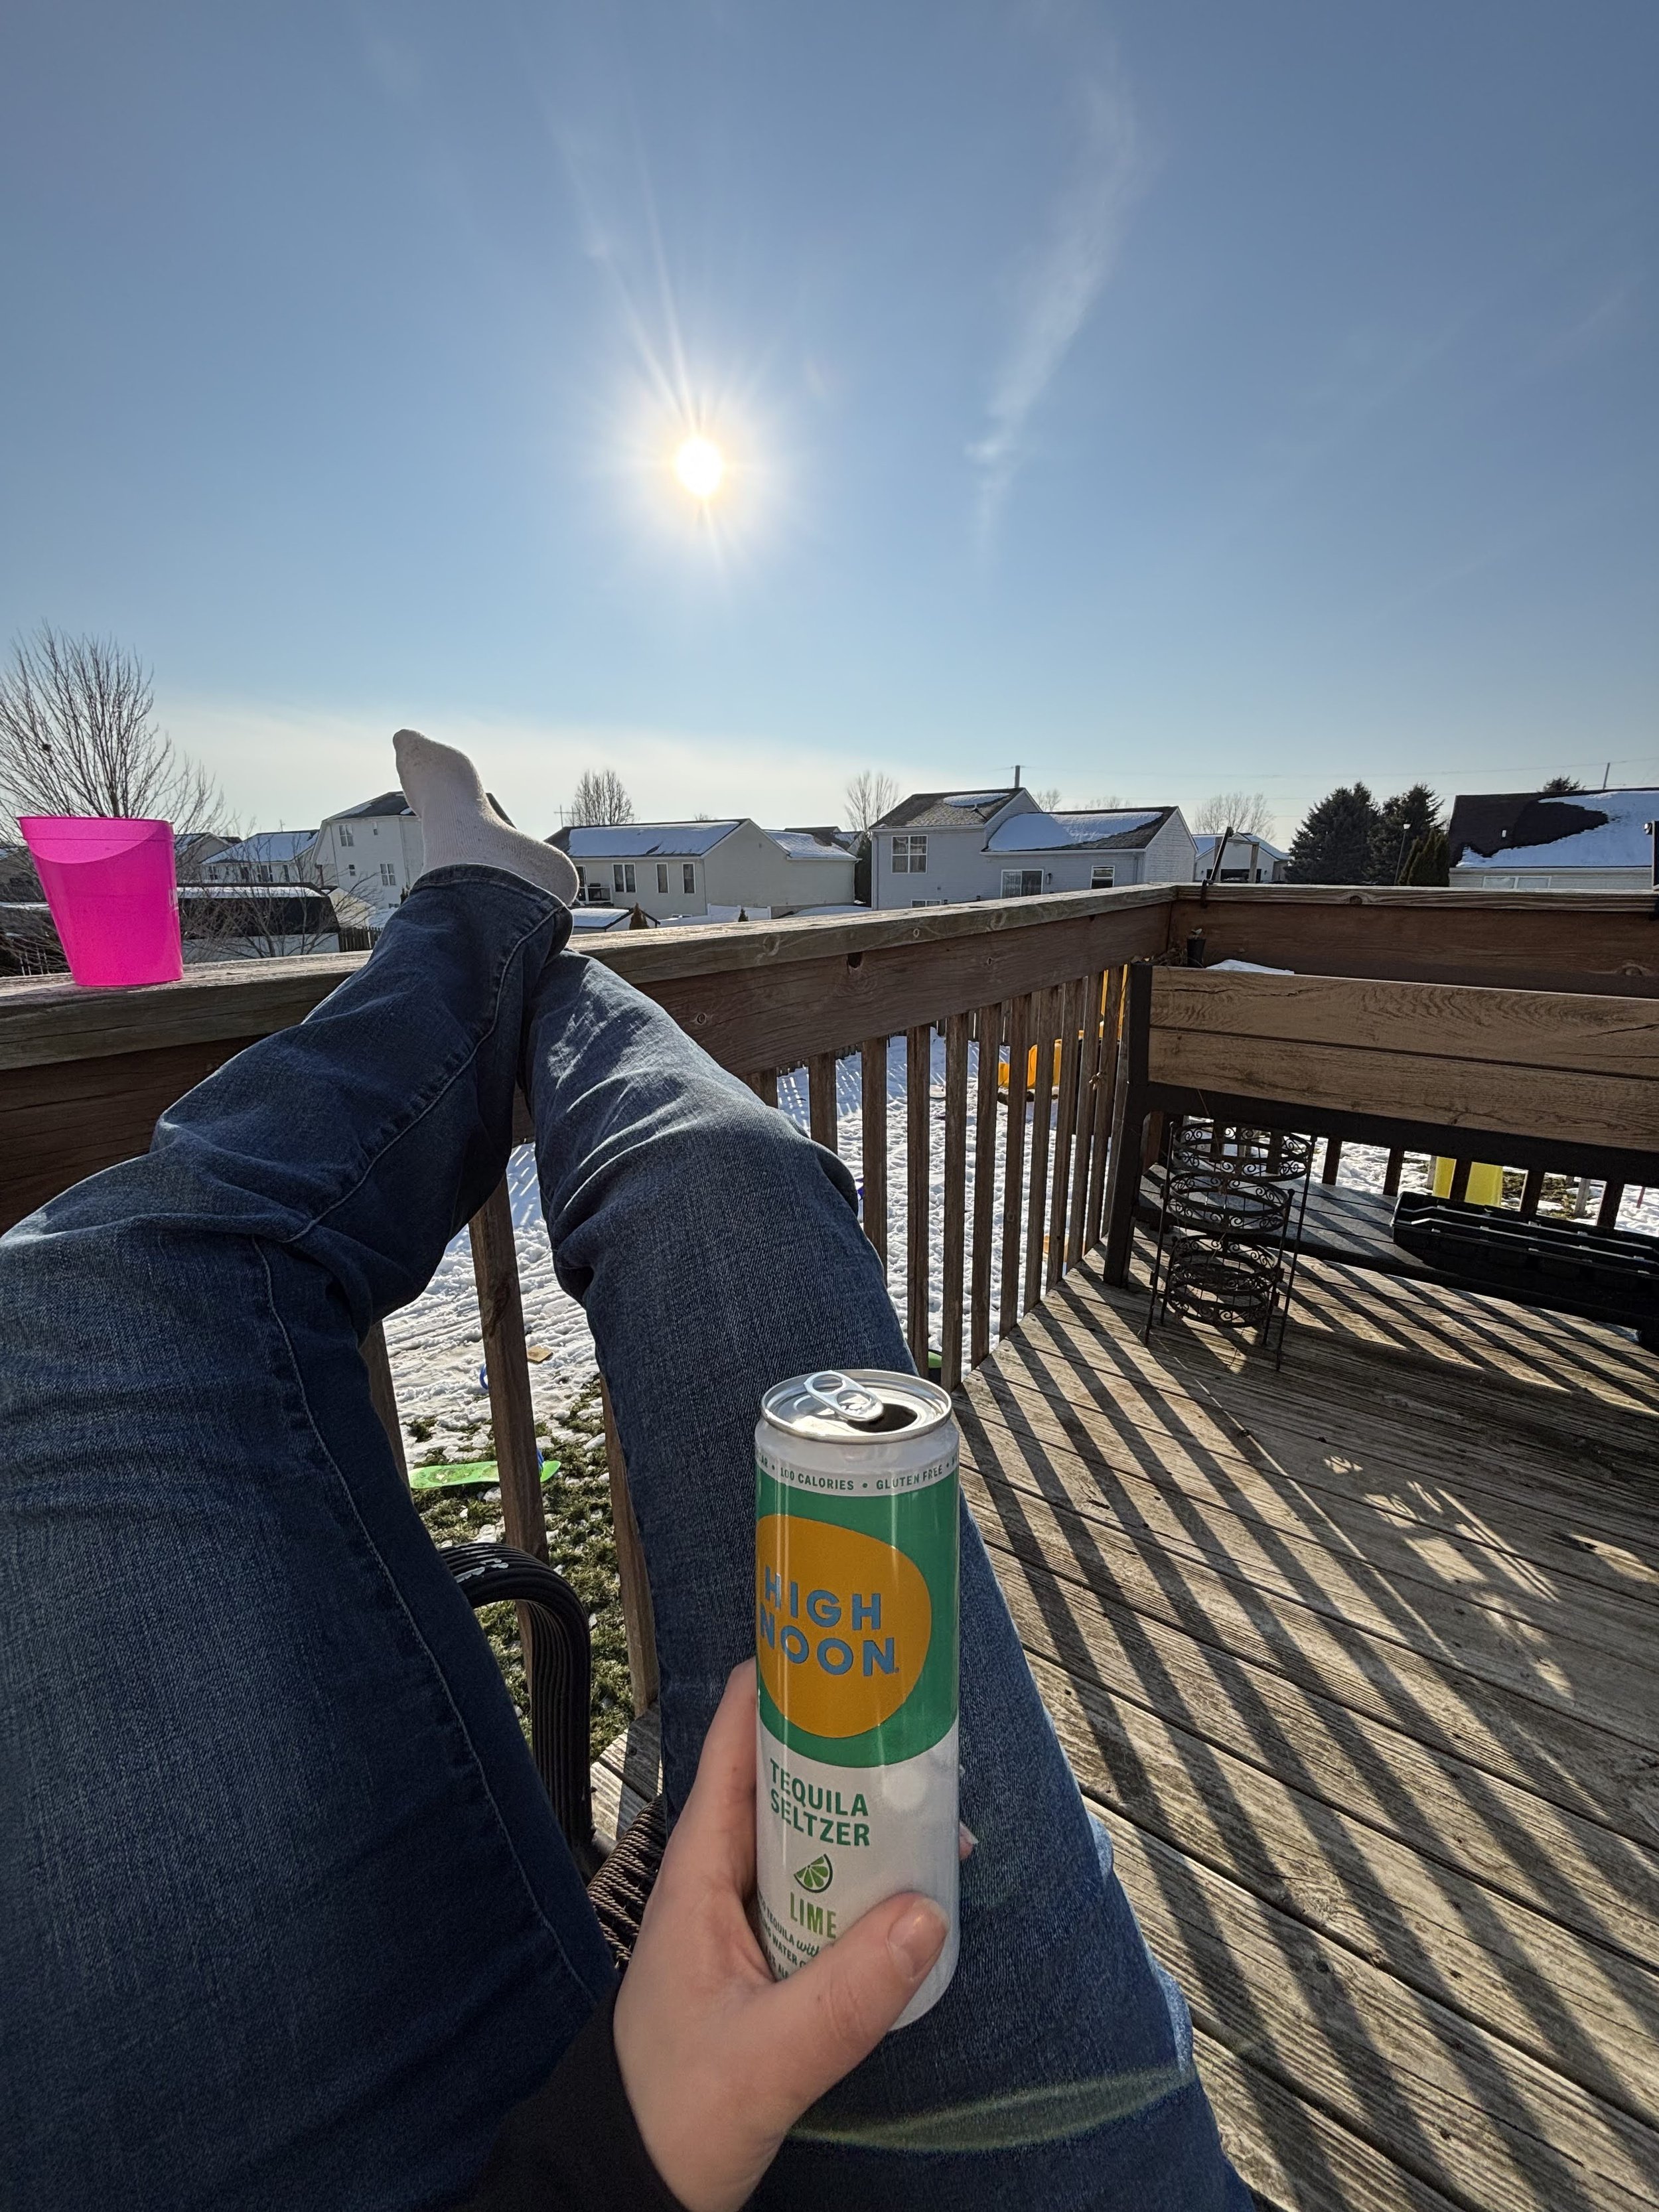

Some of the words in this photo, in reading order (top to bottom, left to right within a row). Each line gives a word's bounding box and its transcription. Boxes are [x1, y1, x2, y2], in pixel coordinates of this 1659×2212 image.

[780, 1467, 795, 1481] 100
[798, 1473, 854, 1491] CALORIES
[876, 1474, 919, 1490] GLUTEN
[922, 1465, 943, 1481] FREE
[765, 1565, 881, 1631] HIGH
[760, 1603, 895, 1677] NOON
[770, 1757, 869, 1816] TEQUILA
[770, 1788, 870, 1846] SELTZER
[766, 1907, 795, 1946] TEQUILA
[790, 1891, 836, 1939] LIME
[772, 1933, 798, 1966] WATER
